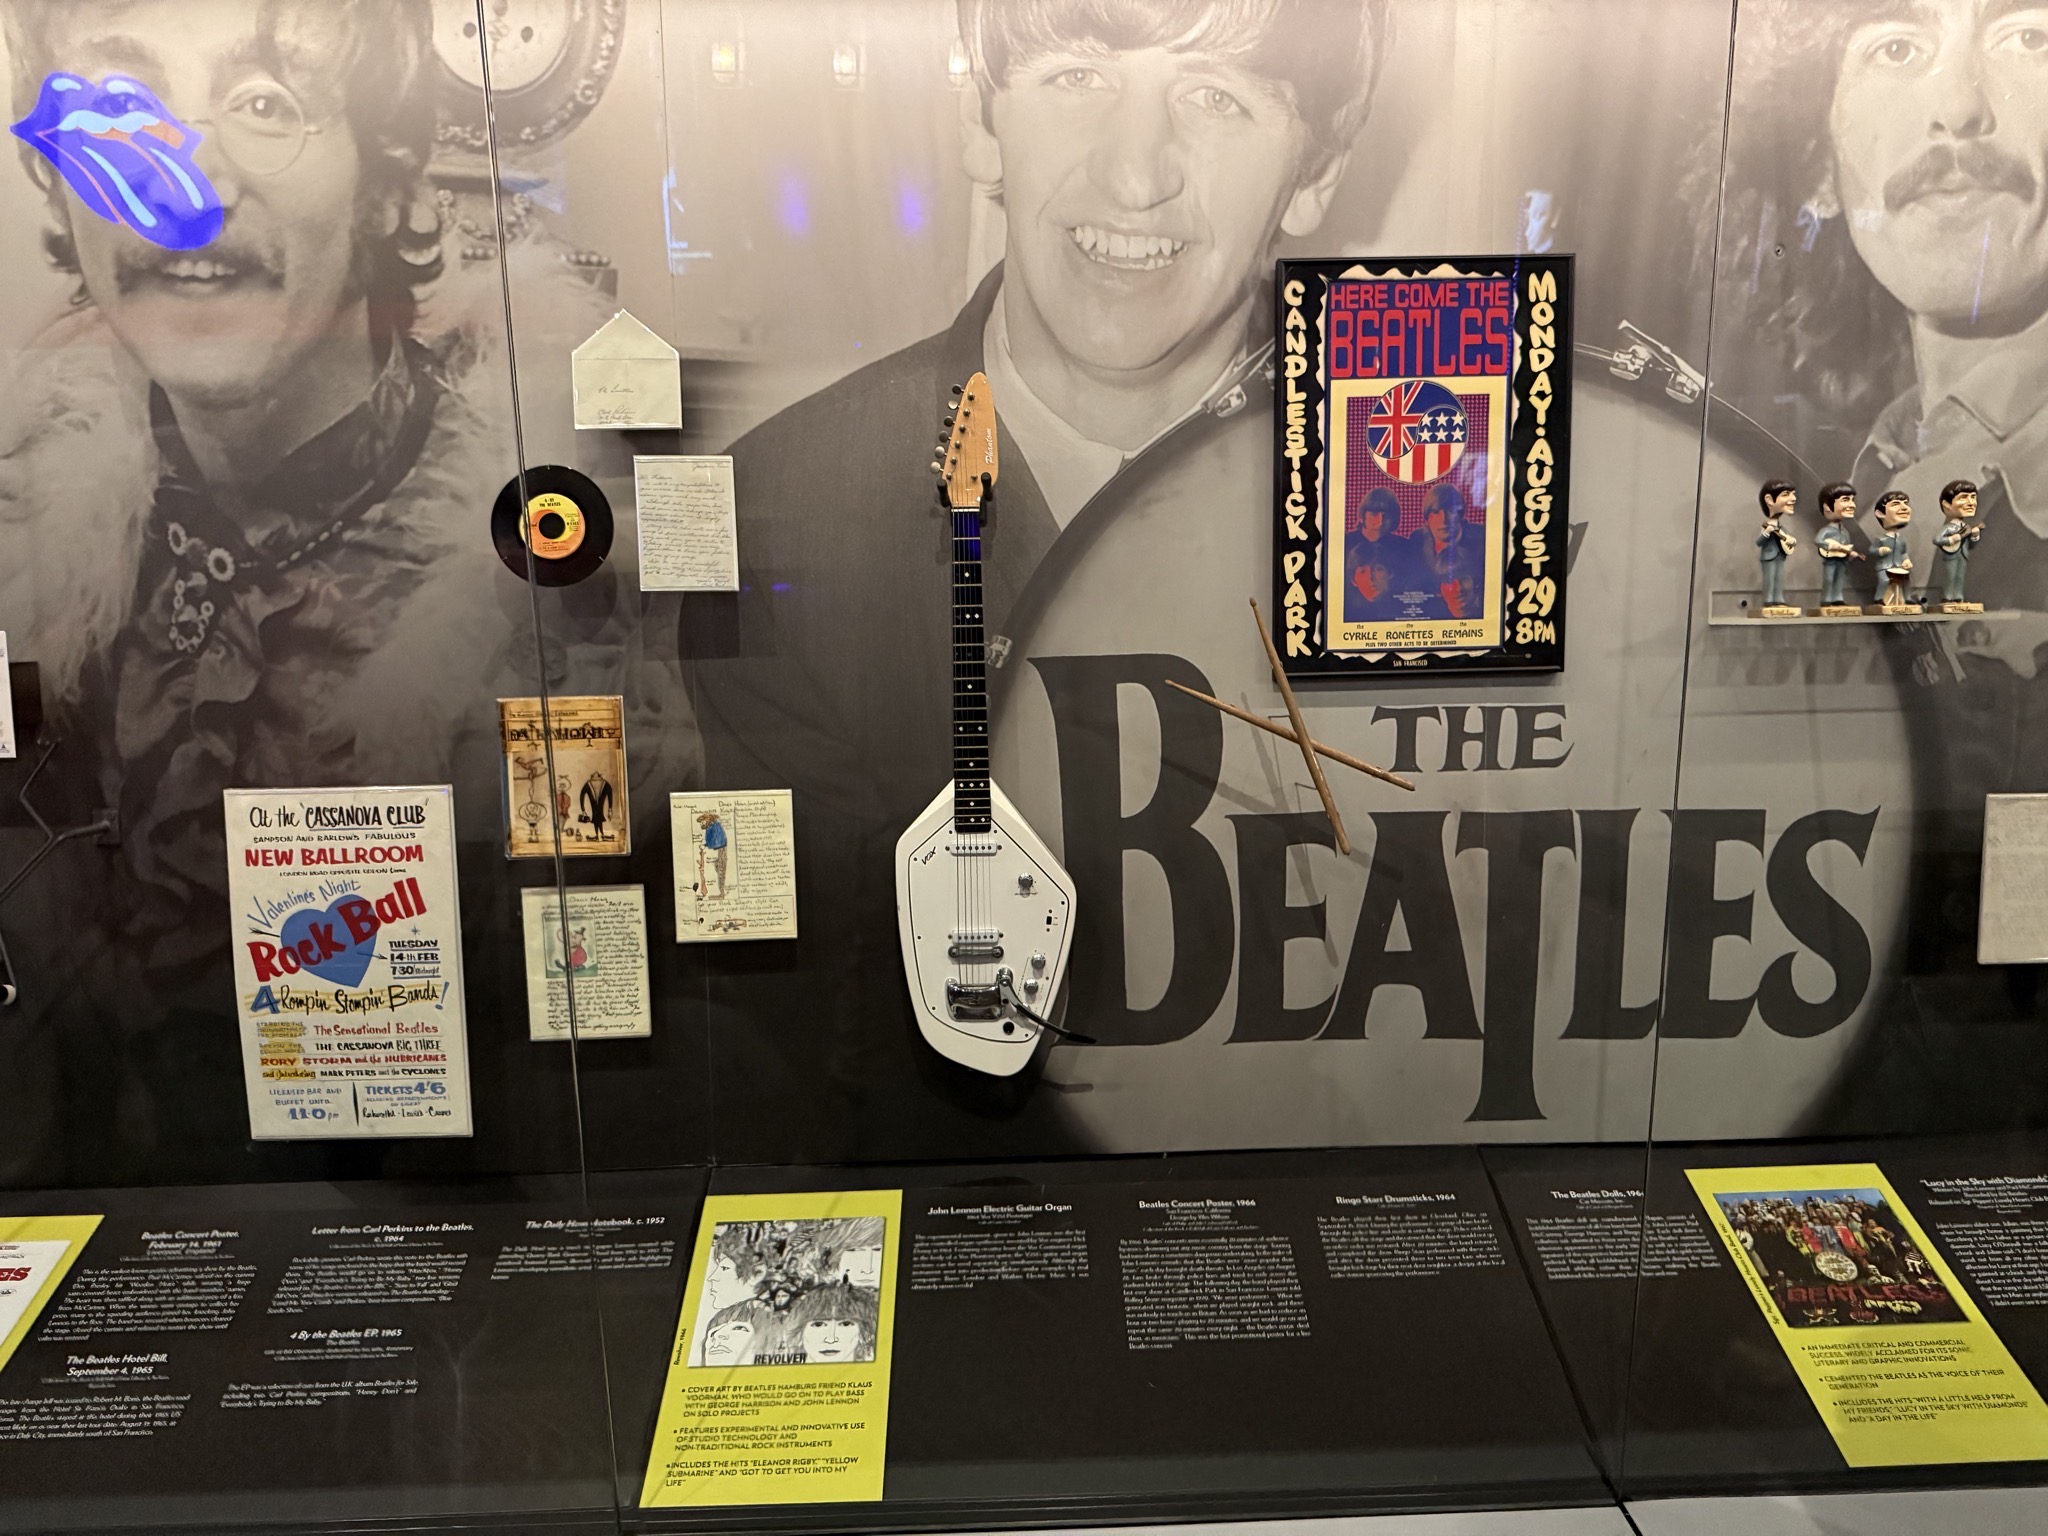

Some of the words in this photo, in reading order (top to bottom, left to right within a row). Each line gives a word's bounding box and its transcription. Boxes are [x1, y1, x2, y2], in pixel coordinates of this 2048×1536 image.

[1330, 285, 1388, 309] HERE
[1394, 283, 1459, 308] COME
[1468, 282, 1509, 306] THE
[1330, 308, 1509, 378] BEATLES
[1284, 280, 1308, 541] CANDLESTICK
[1517, 577, 1556, 616] 29
[1284, 552, 1311, 658] PARK
[1343, 631, 1378, 641] CYRKLE
[1386, 630, 1433, 640] RONETTES
[1442, 629, 1483, 638] REMAINS
[1516, 618, 1556, 645] 8PM
[1404, 659, 1428, 667] FRANCISCO
[1370, 704, 1575, 773] THE
[365, 832, 417, 840] FABULOUS
[245, 848, 294, 867] NEW
[301, 844, 424, 866] BALLROOM
[318, 879, 361, 902] Night
[246, 921, 347, 983] Rock
[337, 877, 427, 946] Ball
[388, 939, 439, 948] TUESDAY
[417, 953, 439, 961] FEB
[250, 985, 281, 1014] 4
[314, 1025, 333, 1036] The
[333, 1023, 391, 1036] Sensational
[396, 1022, 439, 1034] Beatles
[337, 1040, 394, 1051] CASSANOVA
[396, 1039, 413, 1051] BIG
[414, 1039, 442, 1051] THREE
[260, 1058, 297, 1066] RORY
[302, 1056, 352, 1066] STORM
[384, 1054, 447, 1063] HURRICANES
[345, 1069, 377, 1077] PETERS
[364, 1085, 413, 1095] TICKETS
[1955, 1178, 1969, 1186] the
[1969, 1177, 1986, 1187] Sky
[1986, 1177, 2003, 1185] with
[1335, 1196, 1361, 1206] Ringo
[1362, 1195, 1384, 1204] Starr
[1385, 1194, 1434, 1203] Drumsticks,
[1435, 1193, 1456, 1201] 1964
[1550, 1191, 1569, 1200] The
[1569, 1190, 1600, 1199] Beatles
[927, 1207, 949, 1216] John
[950, 1206, 982, 1215] Lennon
[983, 1205, 1014, 1214] Electric
[1016, 1204, 1043, 1213] Guitar
[1045, 1203, 1072, 1212] Organ
[1139, 1201, 1169, 1209] Beatles
[1171, 1200, 1204, 1208] Concert
[1236, 1199, 1256, 1207] 1966
[312, 1226, 339, 1235] Letter
[339, 1225, 361, 1234] from
[362, 1225, 382, 1234] Carl
[382, 1224, 413, 1233] Perkins
[425, 1224, 440, 1232] the
[526, 1221, 542, 1230] The
[543, 1220, 565, 1230] Daily
[141, 1231, 172, 1240] Beatles
[175, 1231, 209, 1239] Concert
[384, 1235, 404, 1243] 1964
[149, 1241, 187, 1250] February
[203, 1240, 222, 1248] 1961
[290, 1332, 297, 1340] 4
[297, 1331, 311, 1341] By
[312, 1330, 327, 1339] the
[327, 1329, 362, 1339] Beatles
[381, 1329, 403, 1337] 1965
[67, 1356, 85, 1365] The
[86, 1355, 121, 1365] Beatles
[121, 1354, 149, 1363] Hotel
[754, 1353, 807, 1365] REVOLVER
[66, 1367, 119, 1378] September
[132, 1366, 153, 1375] 1965
[1824, 1375, 1867, 1383] CEMENTED
[1884, 1372, 1917, 1380] BEATLES
[802, 1398, 824, 1406] JOHN
[826, 1397, 860, 1405] LENNON
[720, 1425, 780, 1433] EXPERIMENTAL
